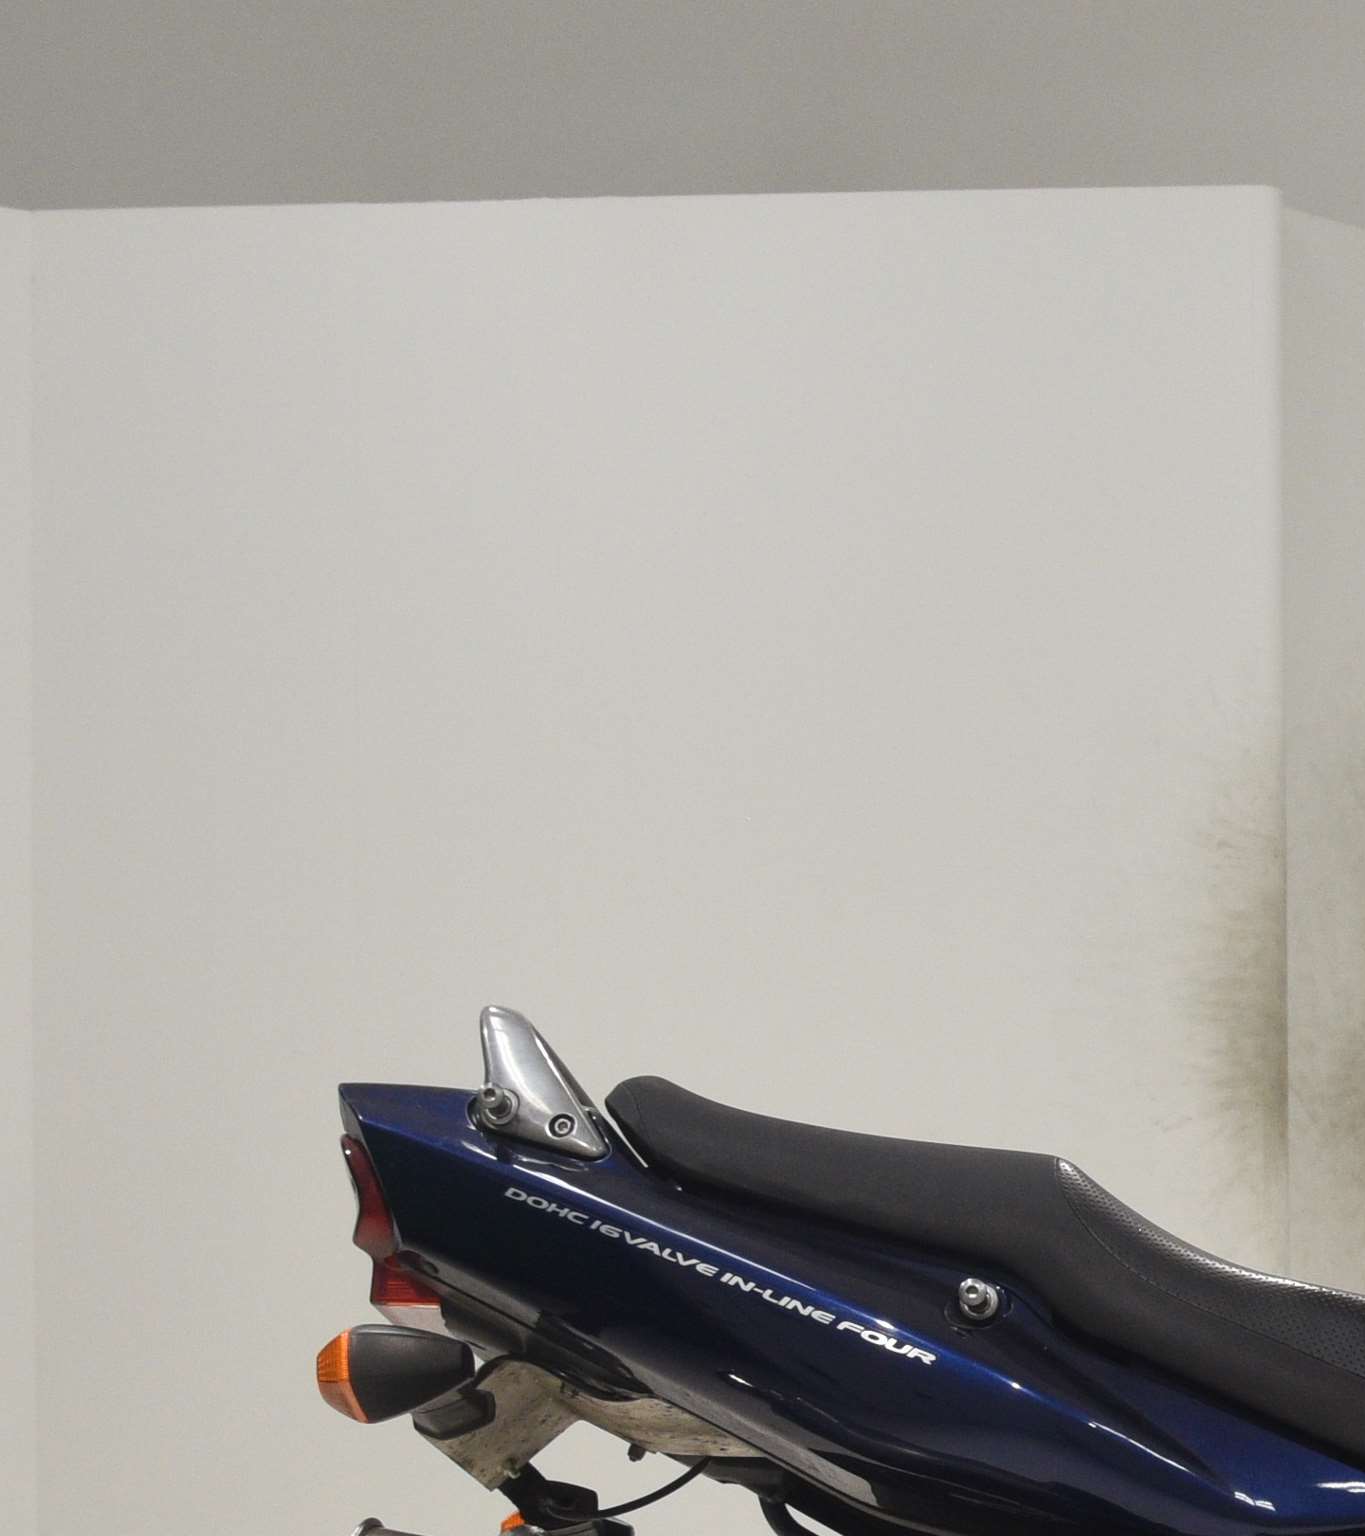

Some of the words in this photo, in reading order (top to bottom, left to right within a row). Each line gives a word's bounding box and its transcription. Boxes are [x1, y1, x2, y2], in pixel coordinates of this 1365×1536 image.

[504, 1187, 590, 1225] DOHC
[719, 1271, 836, 1326] IN-LINE
[836, 1320, 937, 1366] FOUR
